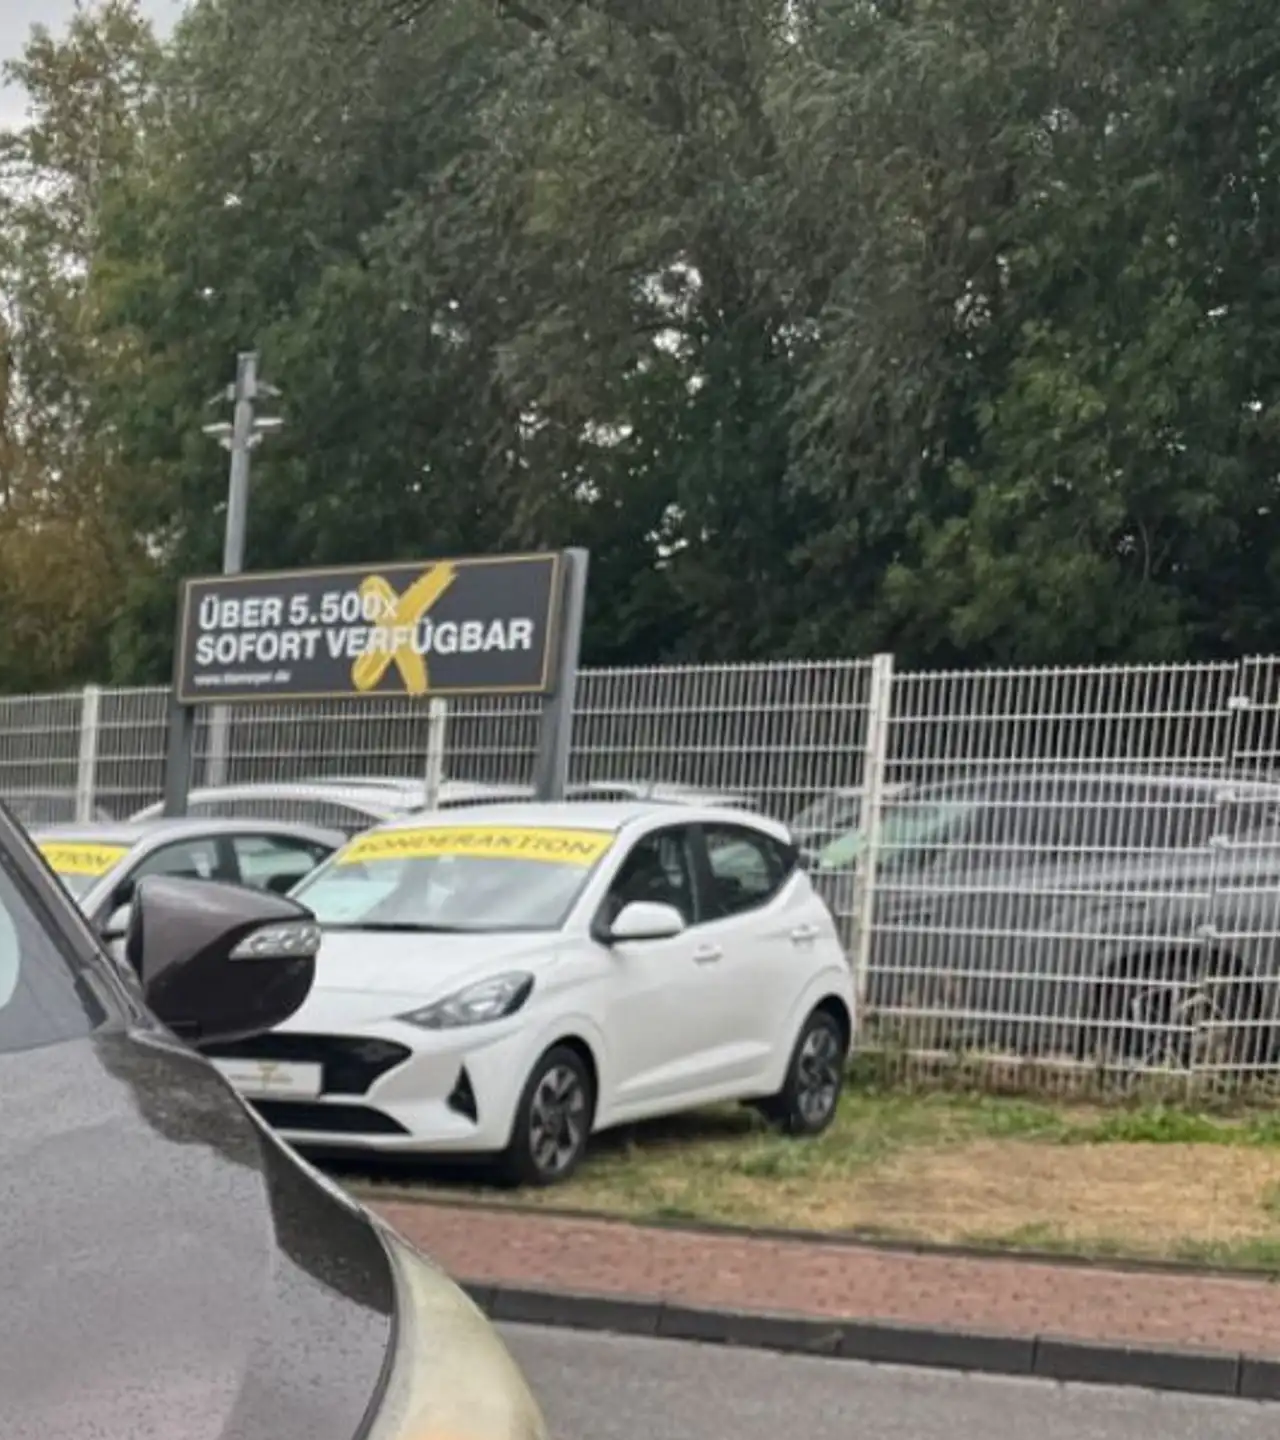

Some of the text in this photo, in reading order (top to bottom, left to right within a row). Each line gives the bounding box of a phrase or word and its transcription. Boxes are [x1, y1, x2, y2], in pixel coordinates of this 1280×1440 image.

[199, 593, 282, 630] ÜBER
[195, 617, 534, 666] SOFORT VERFÜGBAR
